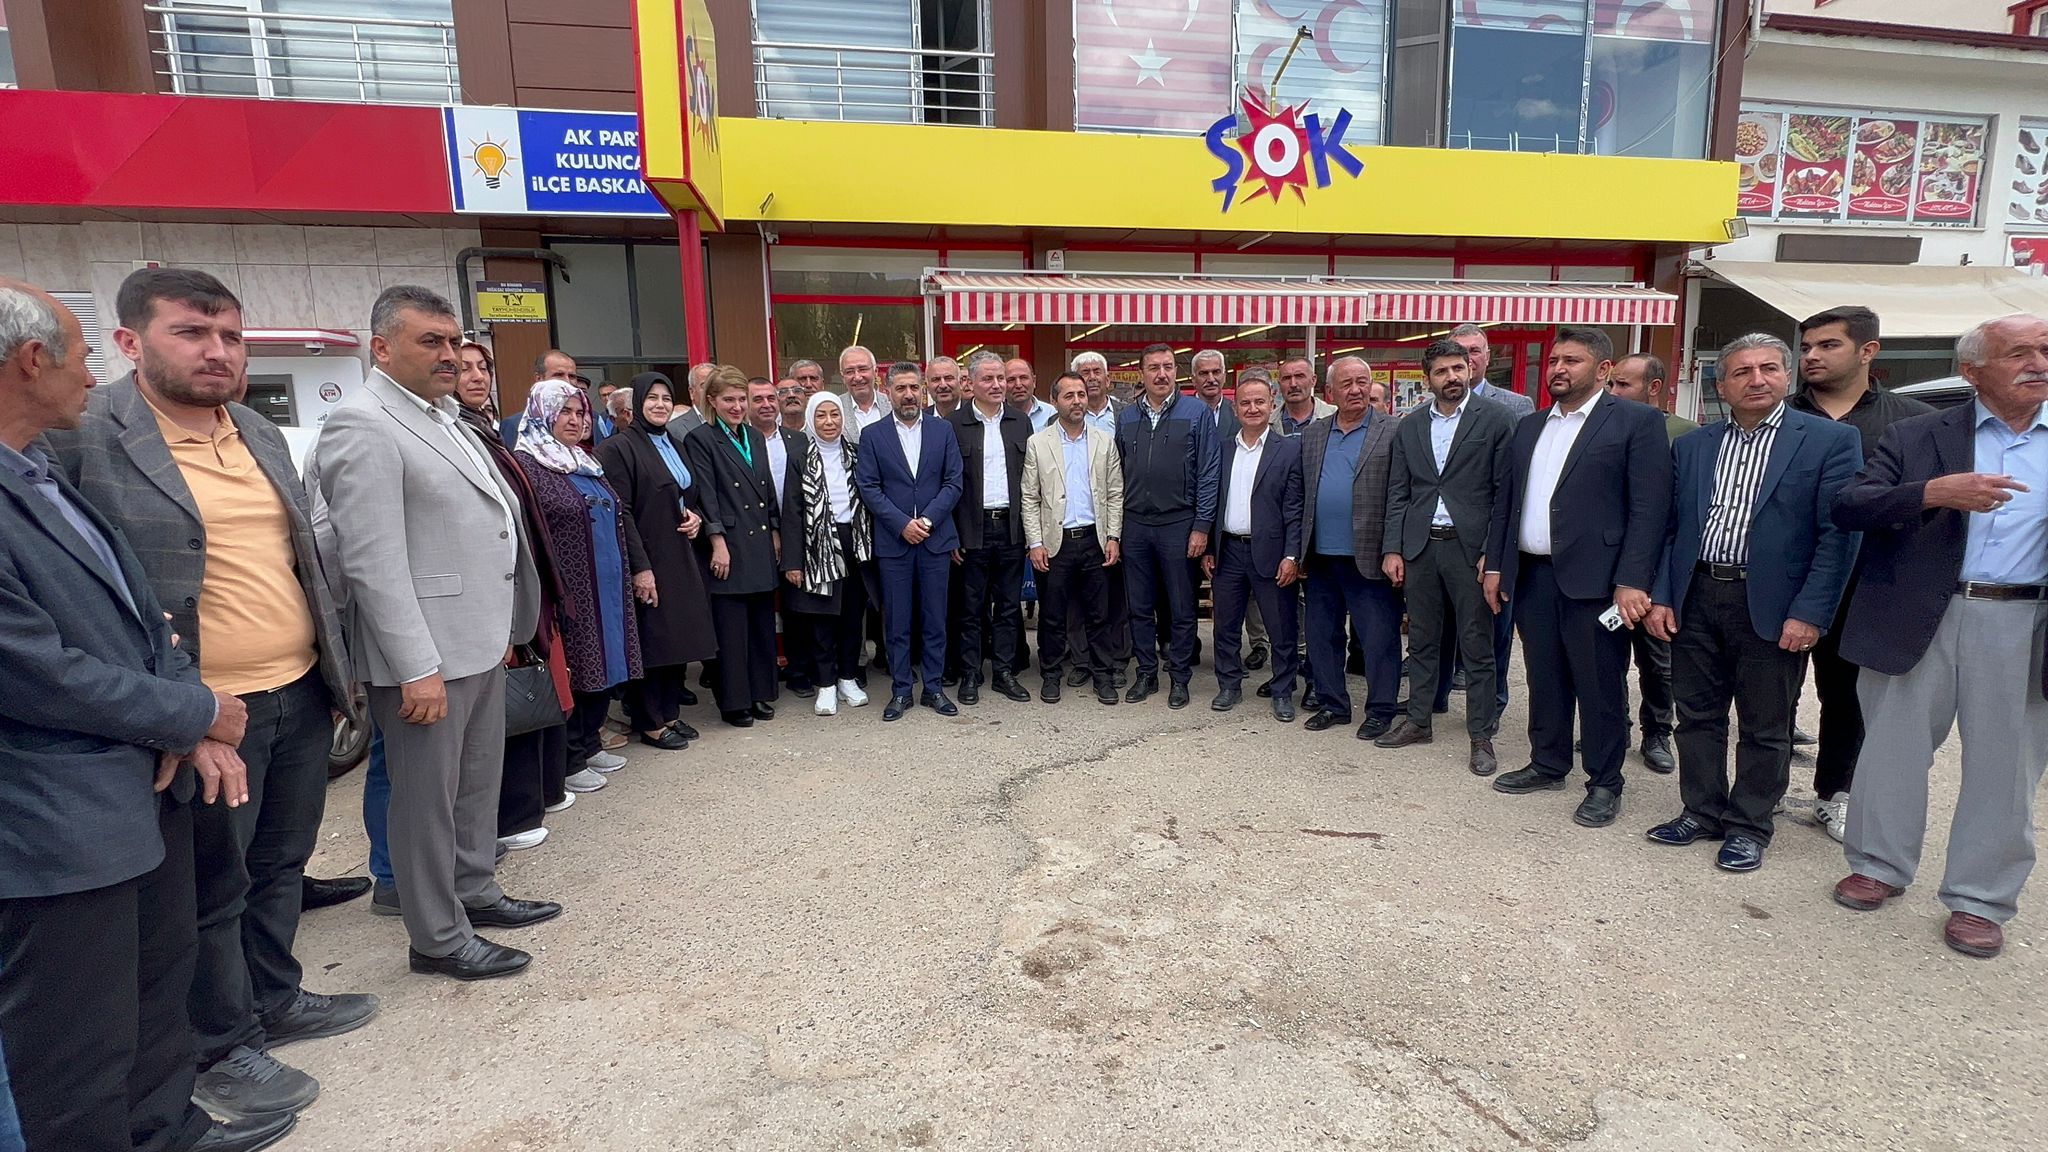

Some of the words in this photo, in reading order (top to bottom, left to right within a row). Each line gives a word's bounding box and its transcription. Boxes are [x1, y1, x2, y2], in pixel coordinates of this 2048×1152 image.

[564, 129, 594, 146] AK
[599, 130, 639, 147] PAR
[1205, 106, 1365, 214] ŞOK
[502, 293, 523, 306] TAY
